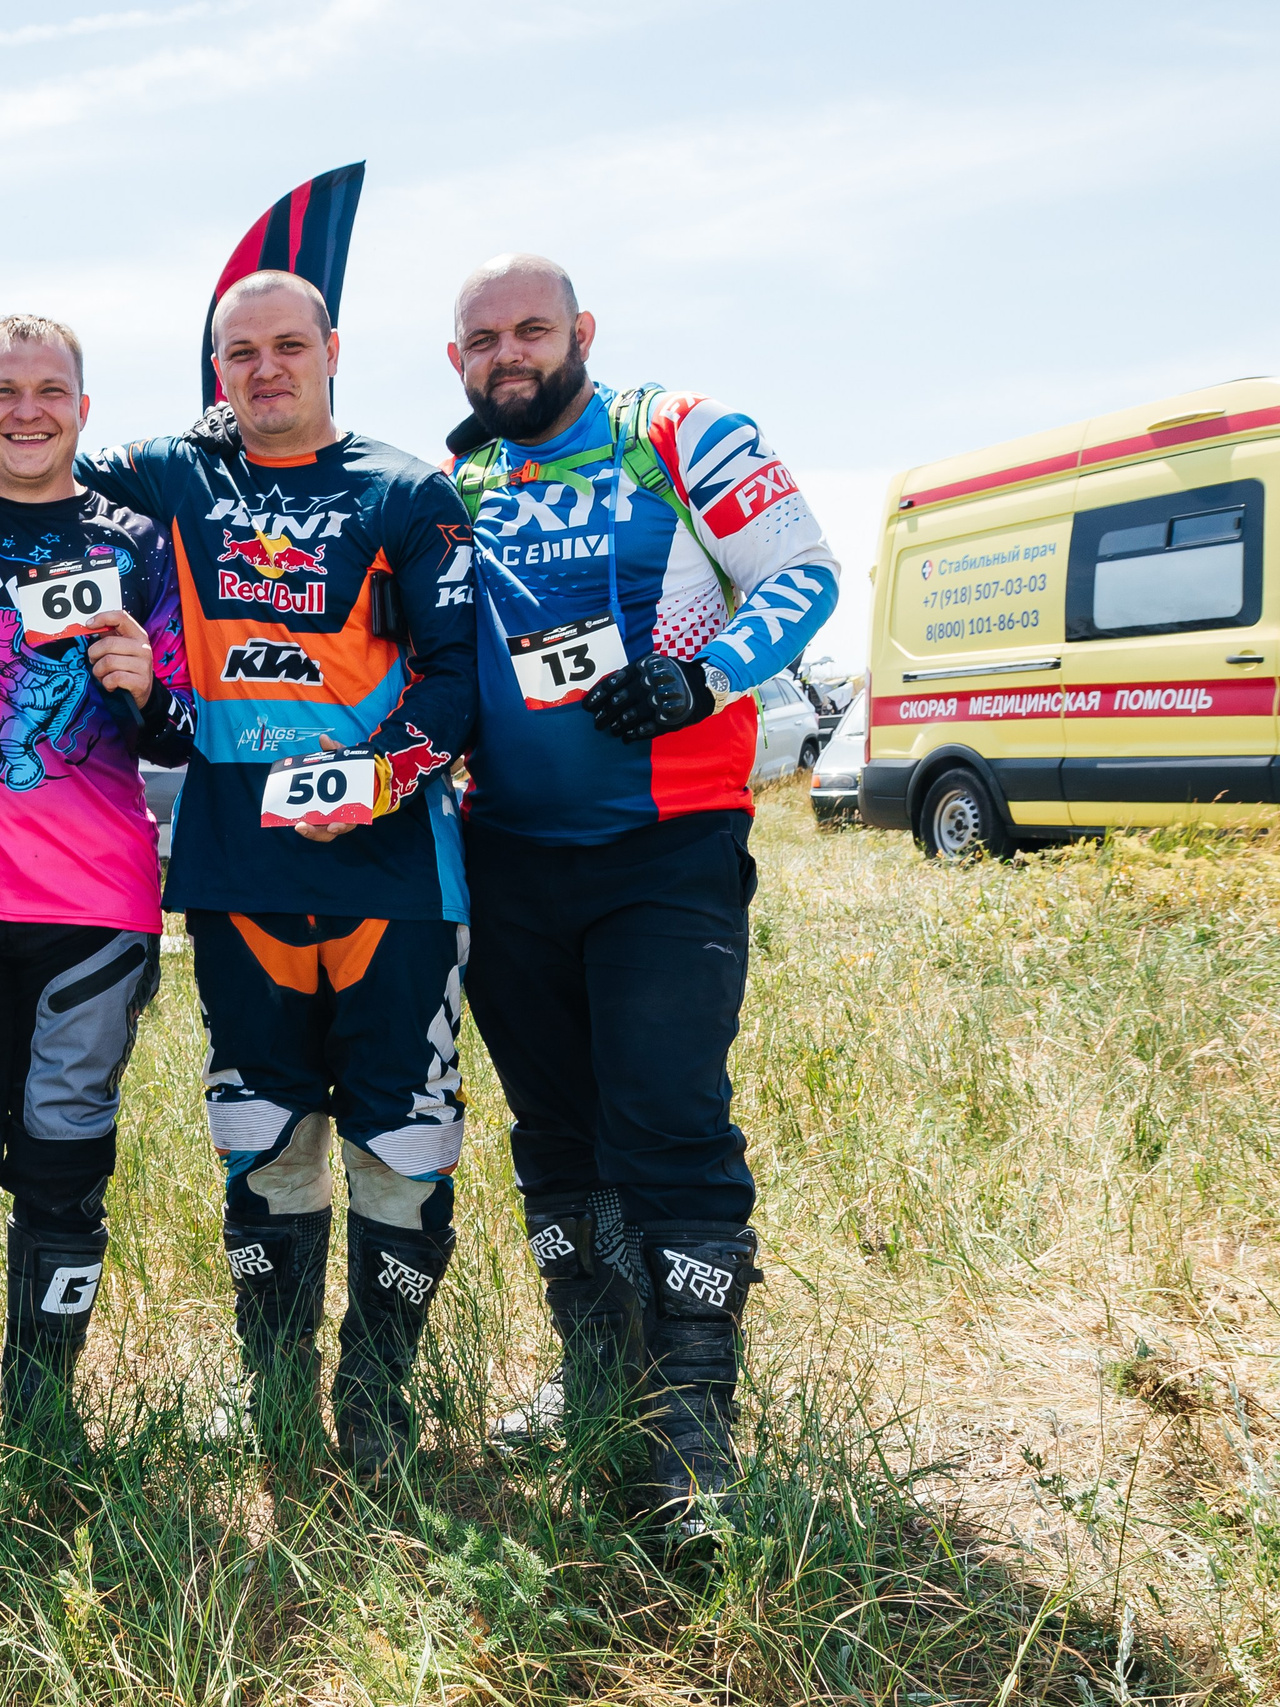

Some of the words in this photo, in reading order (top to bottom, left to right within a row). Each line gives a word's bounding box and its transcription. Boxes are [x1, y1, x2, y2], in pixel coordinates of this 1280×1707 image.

[735, 465, 797, 519] FXR
[938, 545, 1021, 576] Стабильный
[1023, 542, 1057, 563] врач
[42, 579, 103, 620] 60
[219, 569, 272, 603] Red
[273, 581, 325, 614] Bull
[923, 591, 938, 609] +7
[940, 585, 972, 609] (918)
[975, 573, 1047, 601] 507-03-03
[926, 619, 965, 643] 8(800)
[968, 609, 1039, 636] 101-86-03
[222, 640, 322, 684] KTM
[541, 643, 596, 687] 13
[900, 697, 958, 719] СКОРАЯ
[969, 690, 1101, 718] МЕДИЦИНСКАЯ
[1113, 688, 1214, 714] ПОМОЩЬ
[245, 728, 296, 740] WINGS
[251, 740, 280, 752] LIFE
[286, 768, 348, 805] 50
